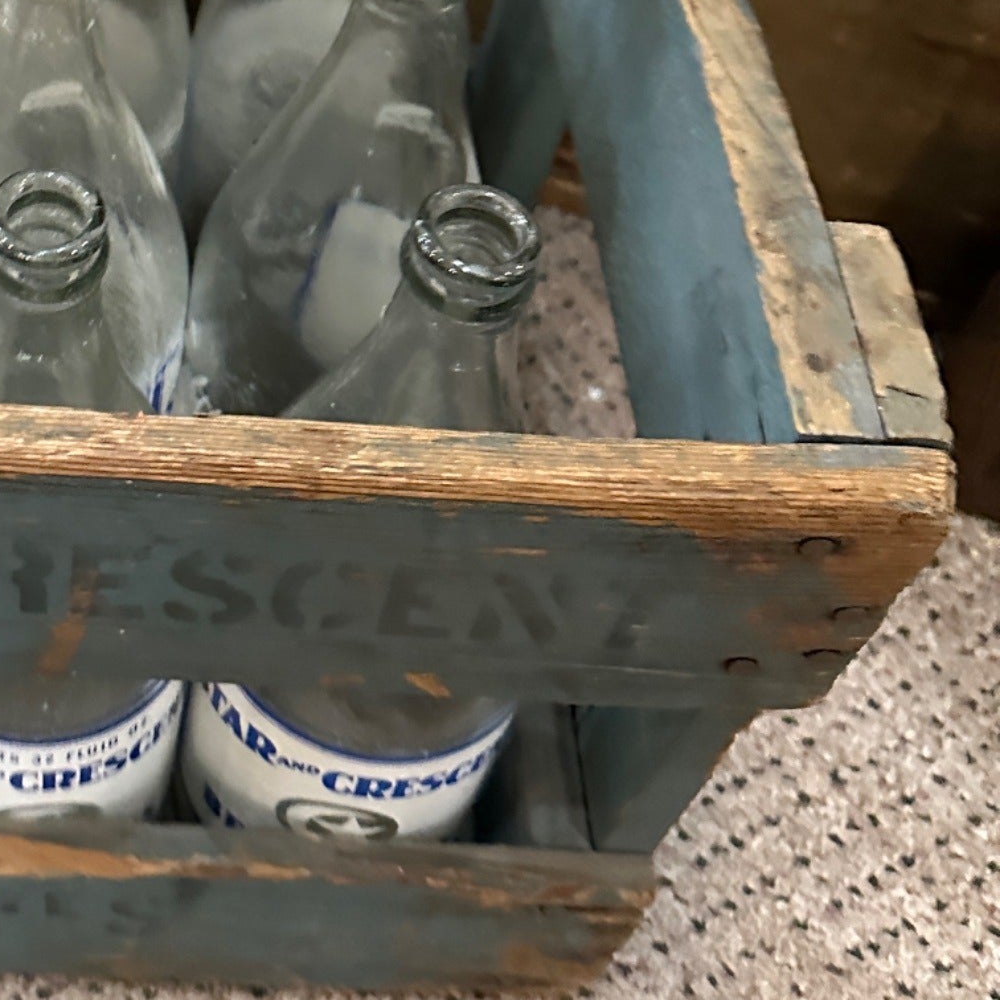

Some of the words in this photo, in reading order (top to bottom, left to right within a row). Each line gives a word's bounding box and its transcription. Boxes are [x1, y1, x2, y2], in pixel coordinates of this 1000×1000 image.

[66, 733, 119, 762] FLUID
[202, 681, 277, 767] TAR
[275, 756, 321, 776] AND
